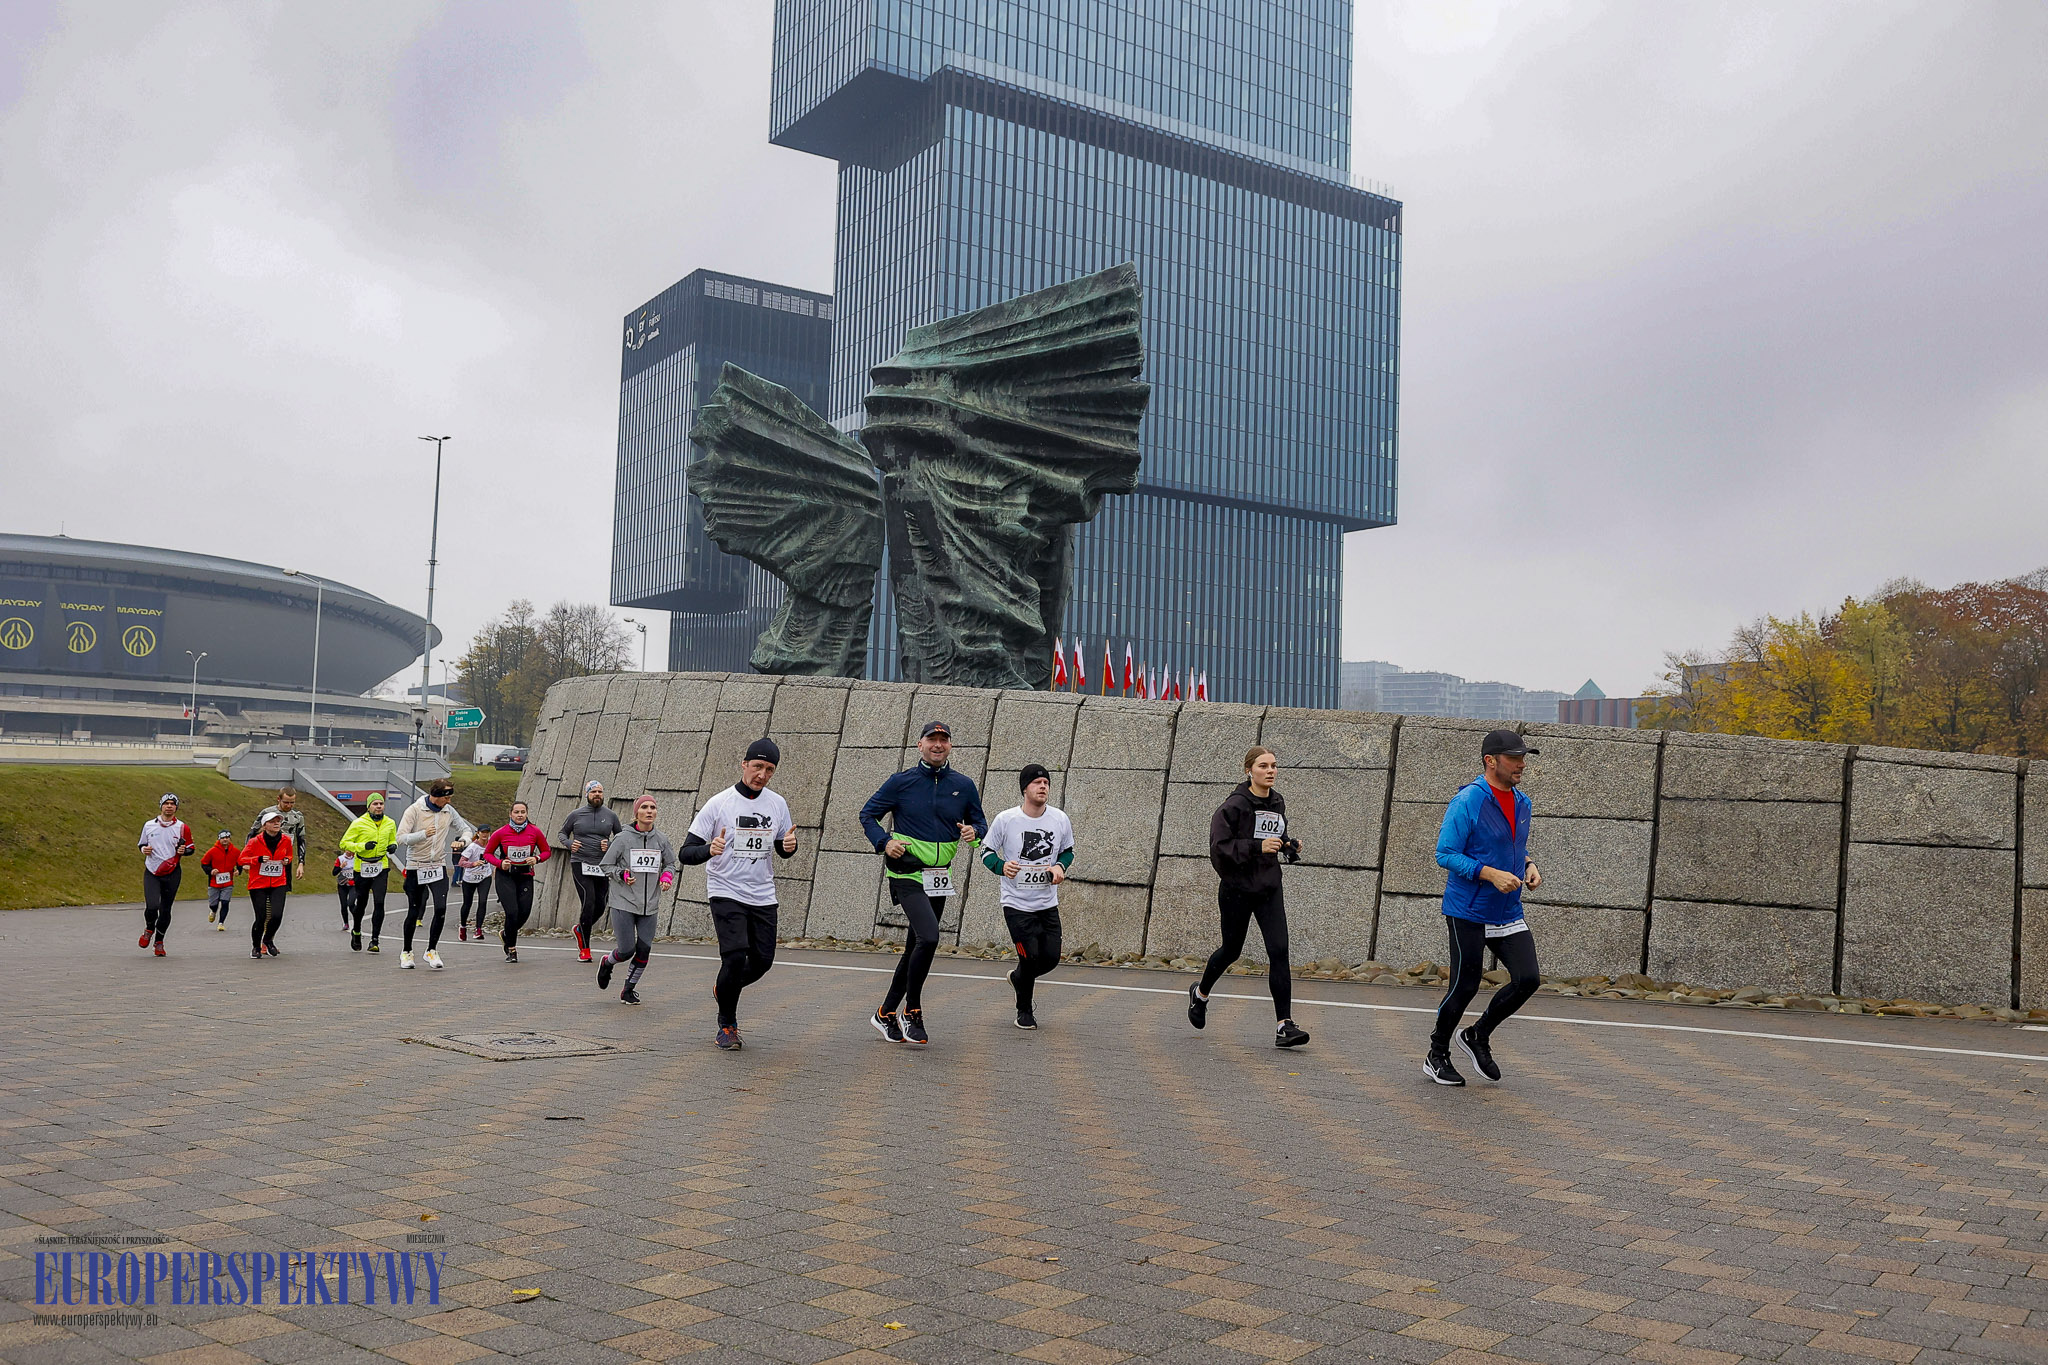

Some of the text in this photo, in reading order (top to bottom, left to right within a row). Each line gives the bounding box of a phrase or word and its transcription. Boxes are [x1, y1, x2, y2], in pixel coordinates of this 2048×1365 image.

[117, 606, 162, 616] MAYDAY
[1261, 820, 1279, 832] 602
[746, 837, 763, 850] 48
[511, 851, 526, 859] 404
[636, 856, 655, 866] 497
[264, 863, 279, 873] 694
[422, 869, 438, 879] 701
[1024, 872, 1045, 883] 266
[933, 876, 949, 888] 89
